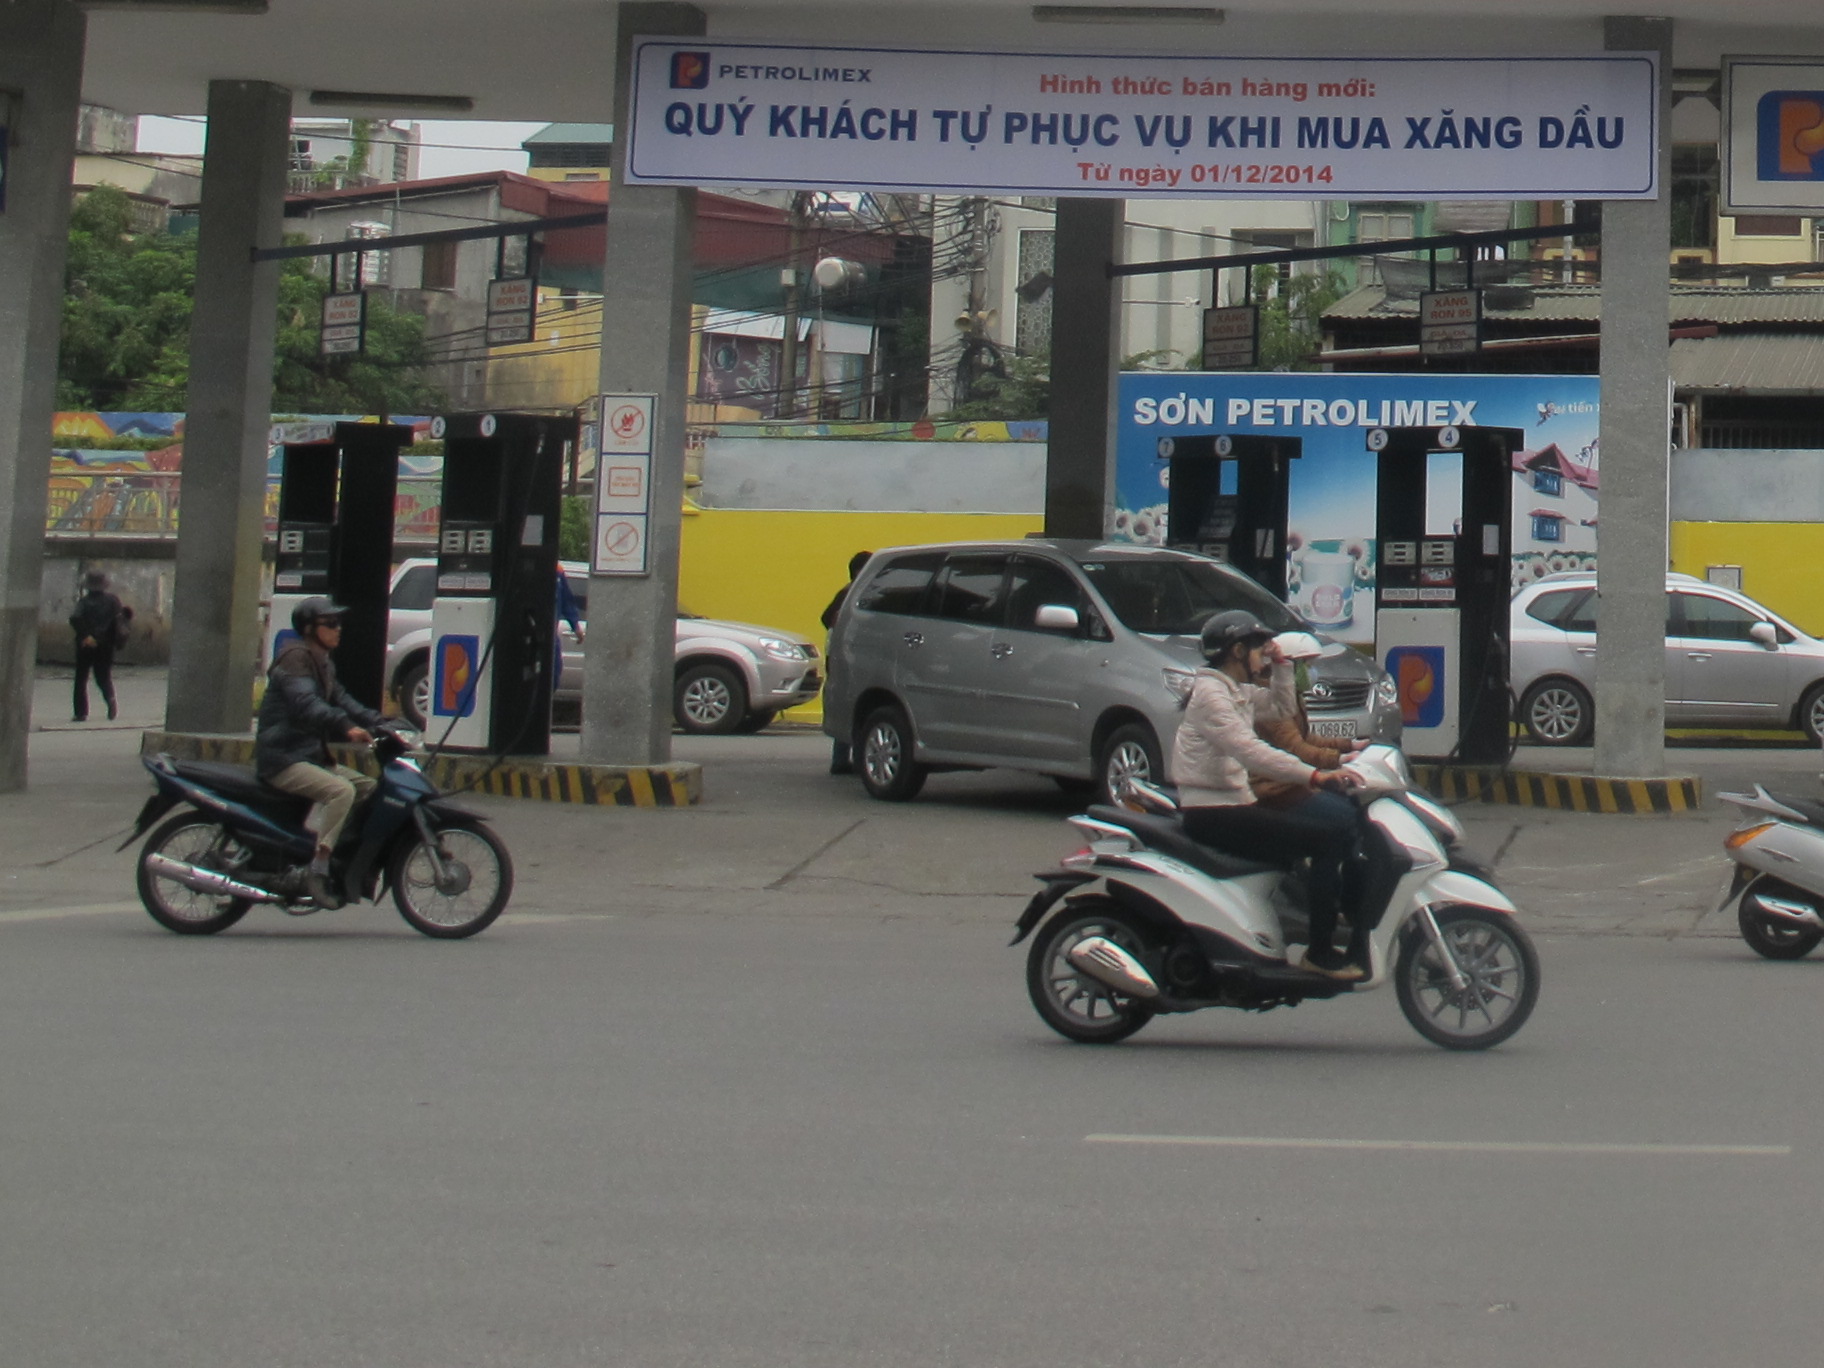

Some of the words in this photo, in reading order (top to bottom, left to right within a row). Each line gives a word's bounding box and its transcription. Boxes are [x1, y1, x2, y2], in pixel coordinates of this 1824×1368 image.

[718, 63, 872, 83] PETROLIMEX
[1039, 73, 1101, 95] Hình
[1111, 75, 1173, 96] thức
[1182, 76, 1232, 97] bán
[1241, 77, 1308, 102] hàng
[1317, 77, 1376, 98] mới:
[665, 96, 754, 136] QUÝ
[769, 100, 918, 142] KHÁCH
[933, 104, 991, 150] TỰ
[1004, 111, 1120, 153] PHỤC
[1134, 113, 1192, 155] VỤ
[1207, 115, 1282, 149] KHI
[1298, 115, 1392, 150] MUA
[1404, 108, 1524, 150] XĂNG
[1538, 104, 1625, 150] DẦU
[1077, 162, 1111, 181] Từ
[1119, 164, 1182, 186] ngày
[1190, 164, 1334, 184] 01/12/2014
[1431, 310, 1455, 320] RON
[1133, 392, 1215, 427] SƠN
[1227, 398, 1477, 428] PETROLIMEX
[1374, 433, 1382, 446] 5
[1444, 429, 1454, 444] 4
[1310, 723, 1355, 738] A-069.62
